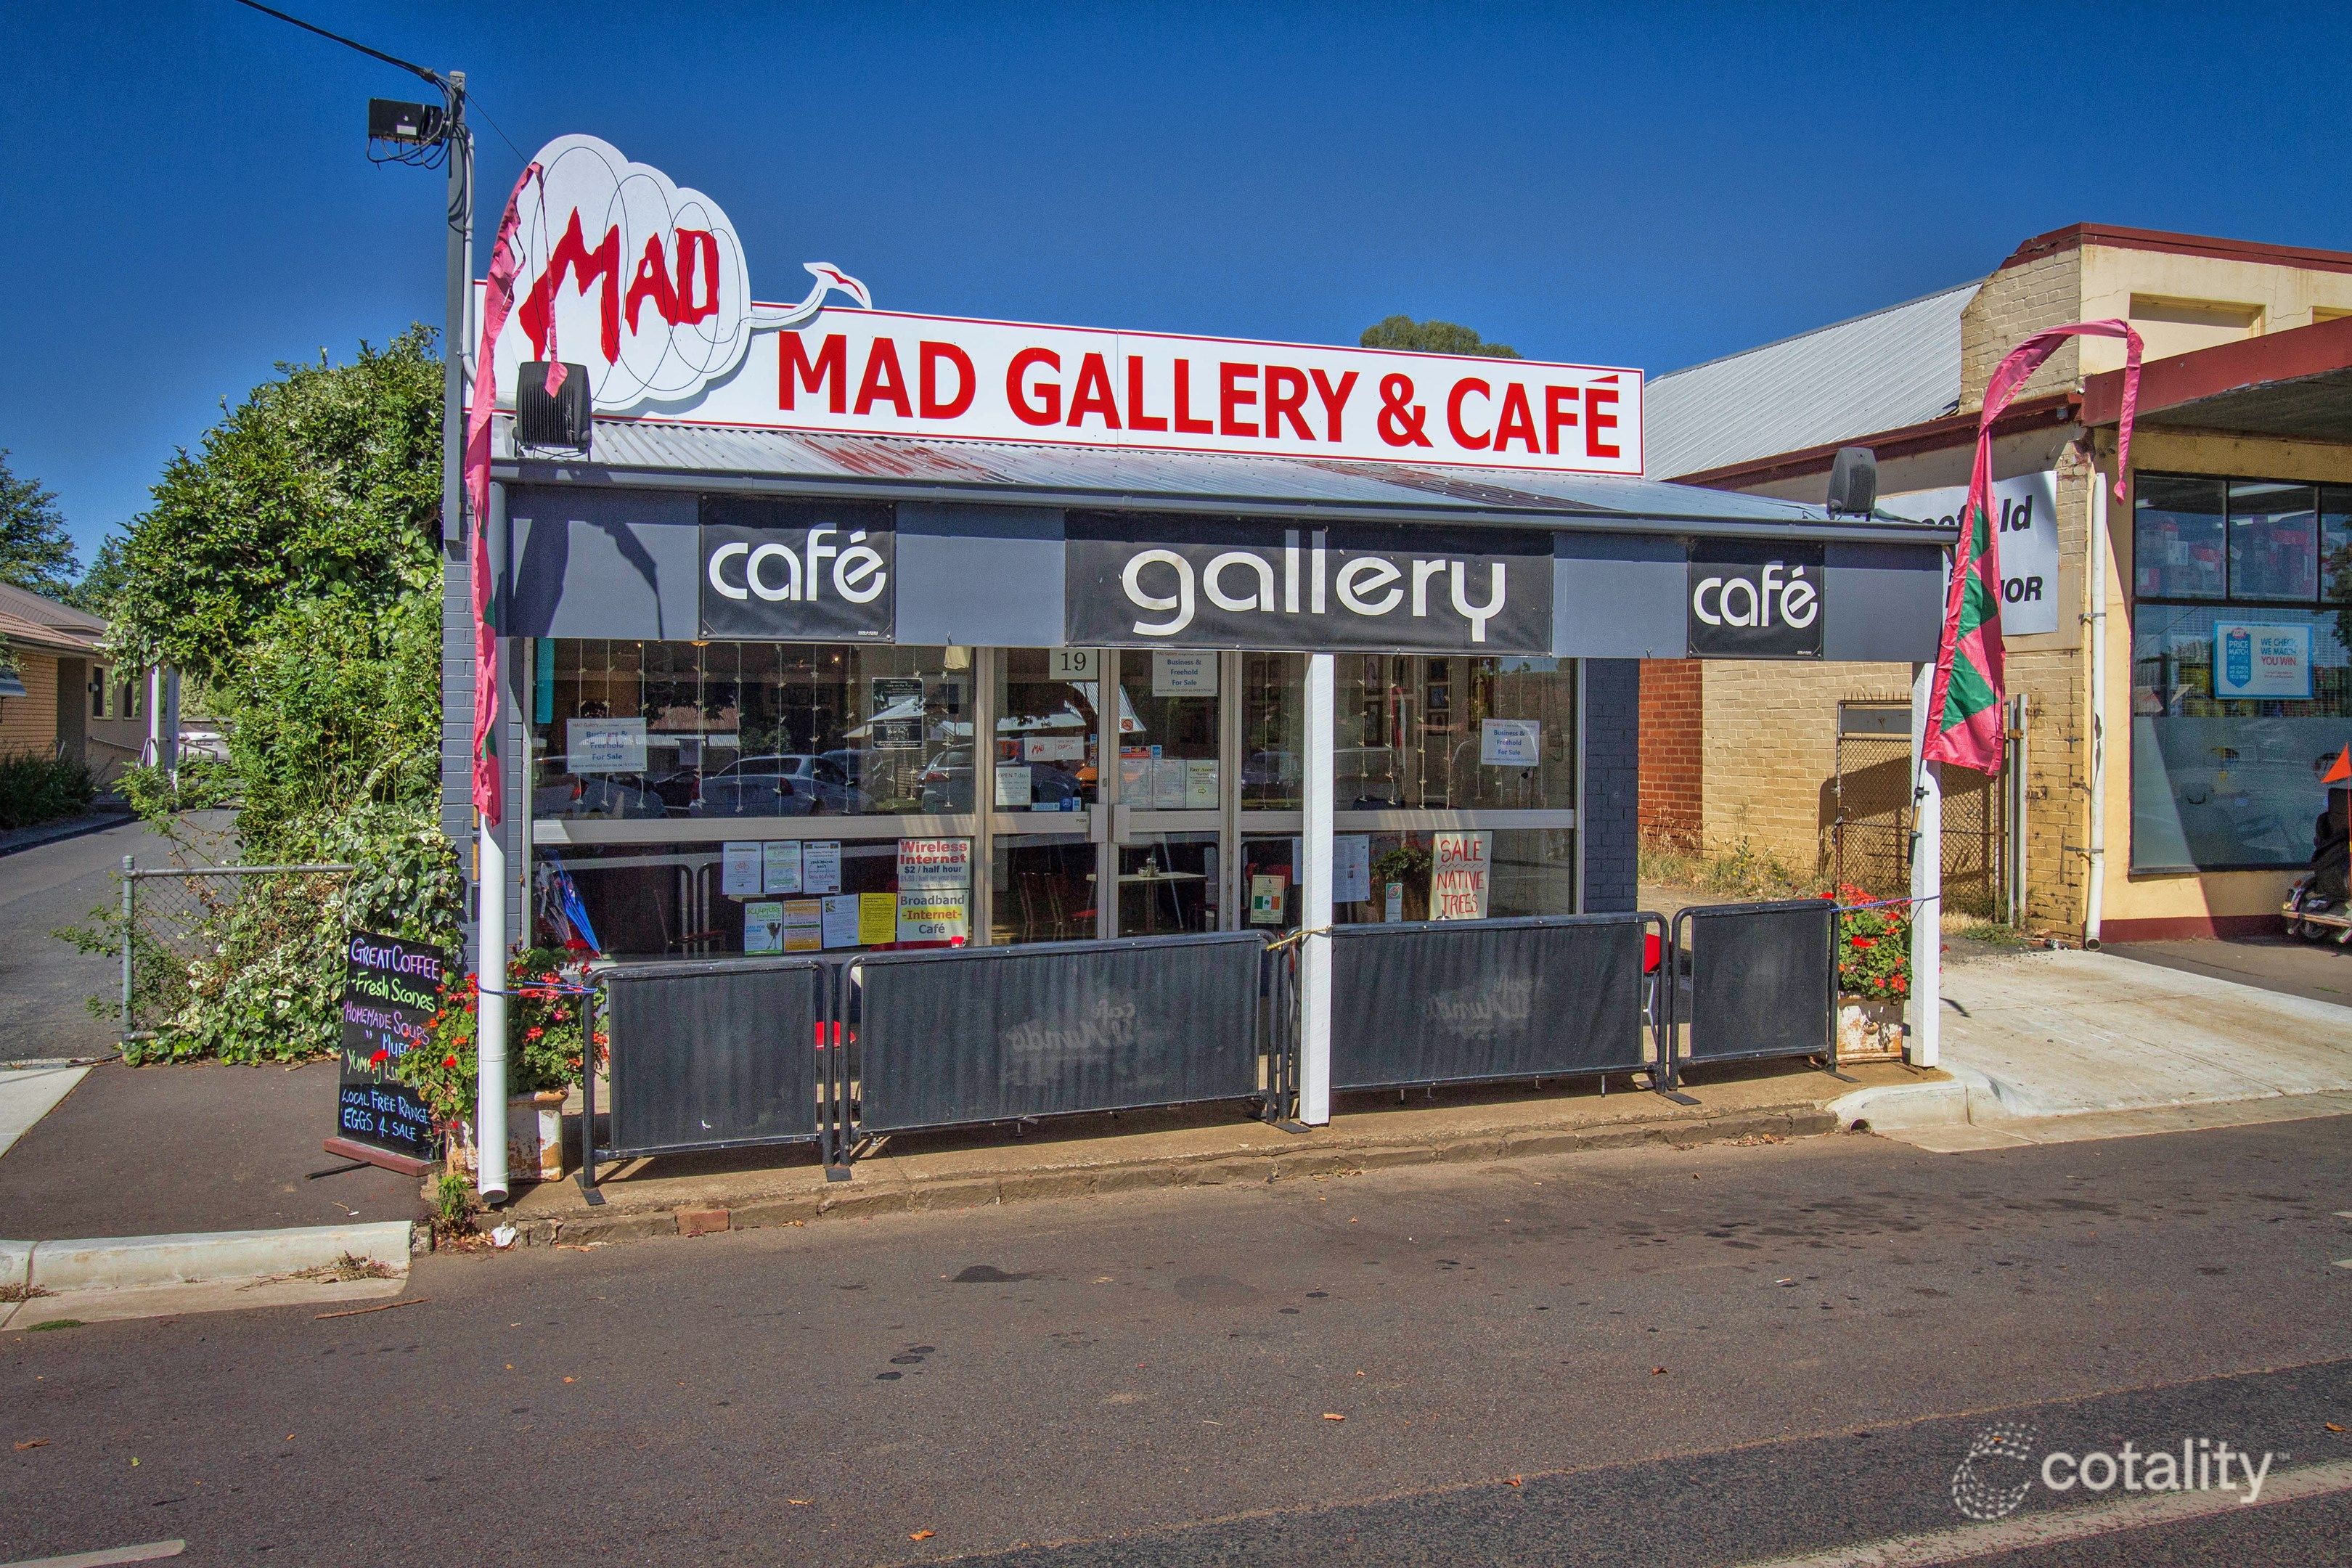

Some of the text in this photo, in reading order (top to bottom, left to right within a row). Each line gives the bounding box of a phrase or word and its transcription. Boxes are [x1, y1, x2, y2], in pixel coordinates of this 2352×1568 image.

[519, 206, 719, 367] MAD
[778, 331, 1620, 459] MAD GALLERY & CAFÉ
[709, 523, 886, 603] café
[1122, 529, 1506, 642] gallery
[1694, 560, 1818, 629] café
[1061, 652, 1087, 671] 19
[2261, 656, 2279, 666] YOU
[900, 841, 968, 854] Wireless
[900, 853, 967, 865] Internet
[1440, 838, 1484, 863] SALE
[1436, 870, 1485, 892] NATIVE
[900, 895, 965, 906] Broadband
[1440, 894, 1478, 916] TREES
[918, 923, 945, 934] Café
[351, 938, 441, 981] GREAT COFFEE
[391, 978, 436, 1013] Scones
[341, 1088, 431, 1125] LOCAL FREE RANGE
[344, 1107, 417, 1142] EGGS 4 SALE
